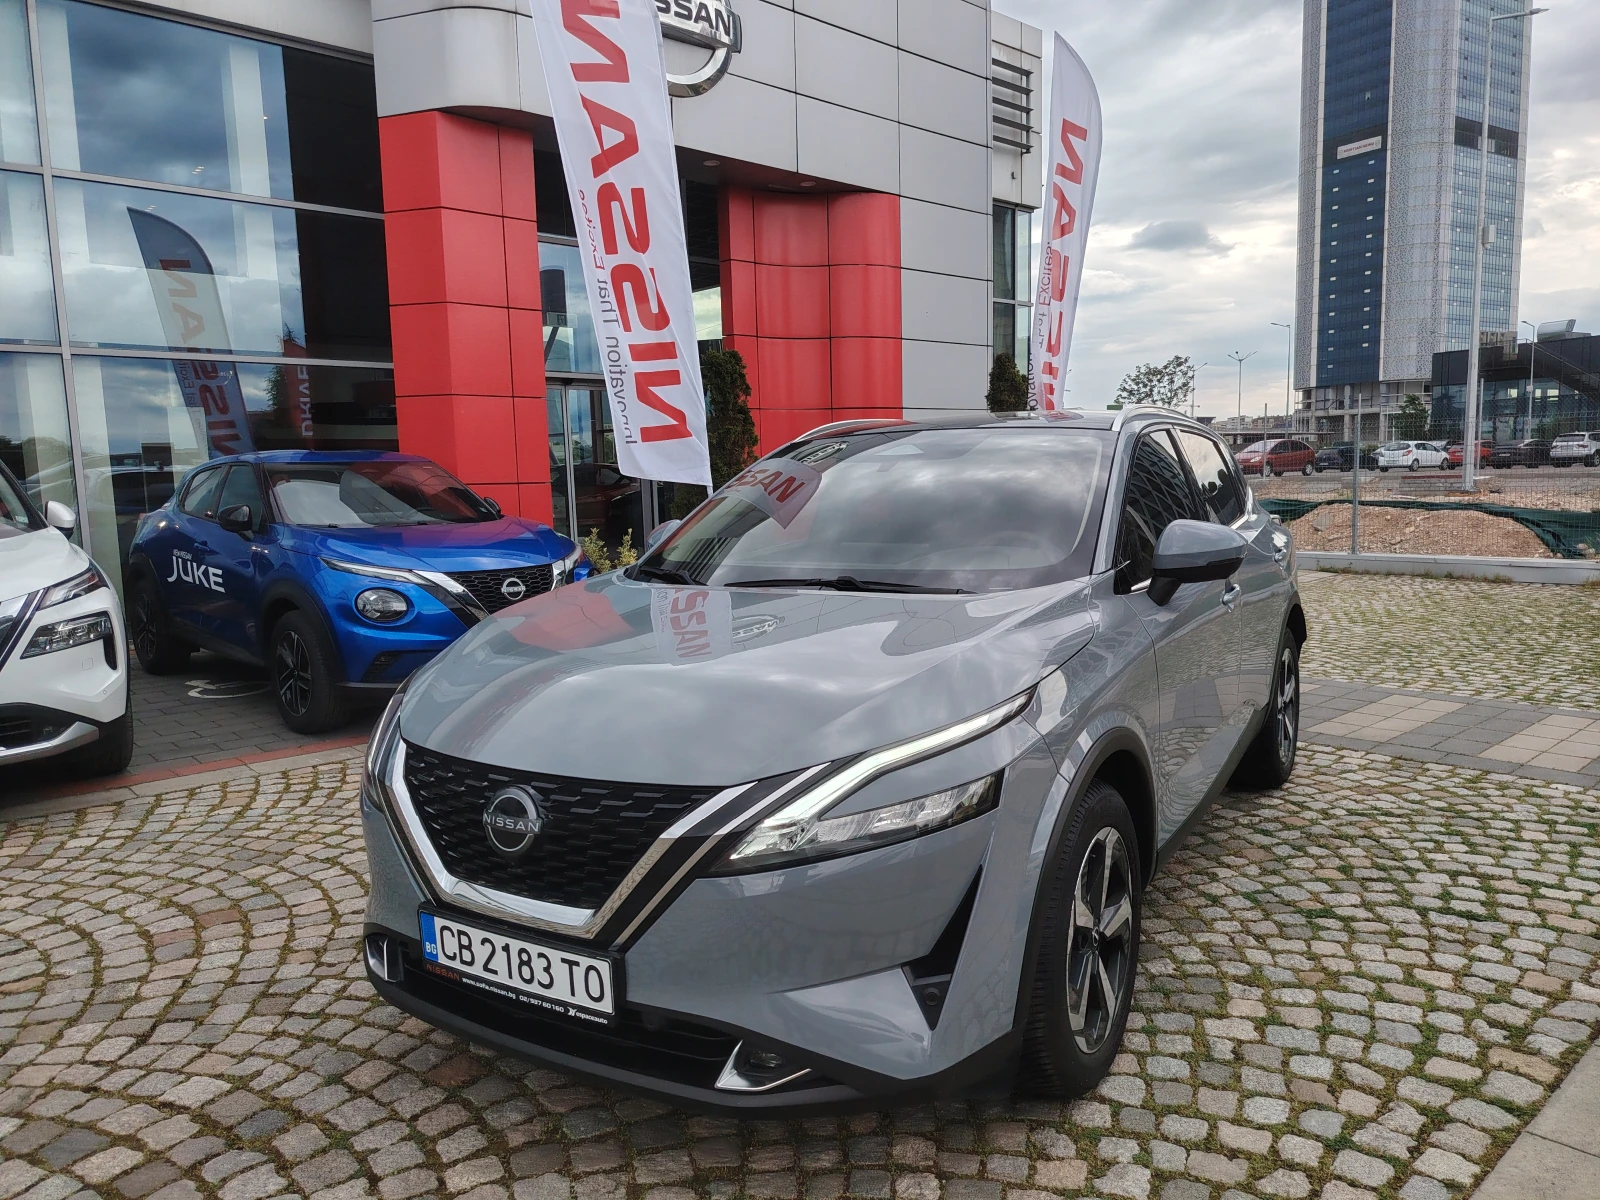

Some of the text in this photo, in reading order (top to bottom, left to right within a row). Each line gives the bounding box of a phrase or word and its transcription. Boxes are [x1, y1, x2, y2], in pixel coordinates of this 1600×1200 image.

[655, 0, 730, 37] SSAN
[166, 556, 225, 593] JUKE
[483, 813, 539, 832] NISSAN
[426, 941, 437, 954] BG
[440, 925, 475, 967] CB
[481, 937, 554, 990] 2183
[427, 963, 460, 980] NISSAN
